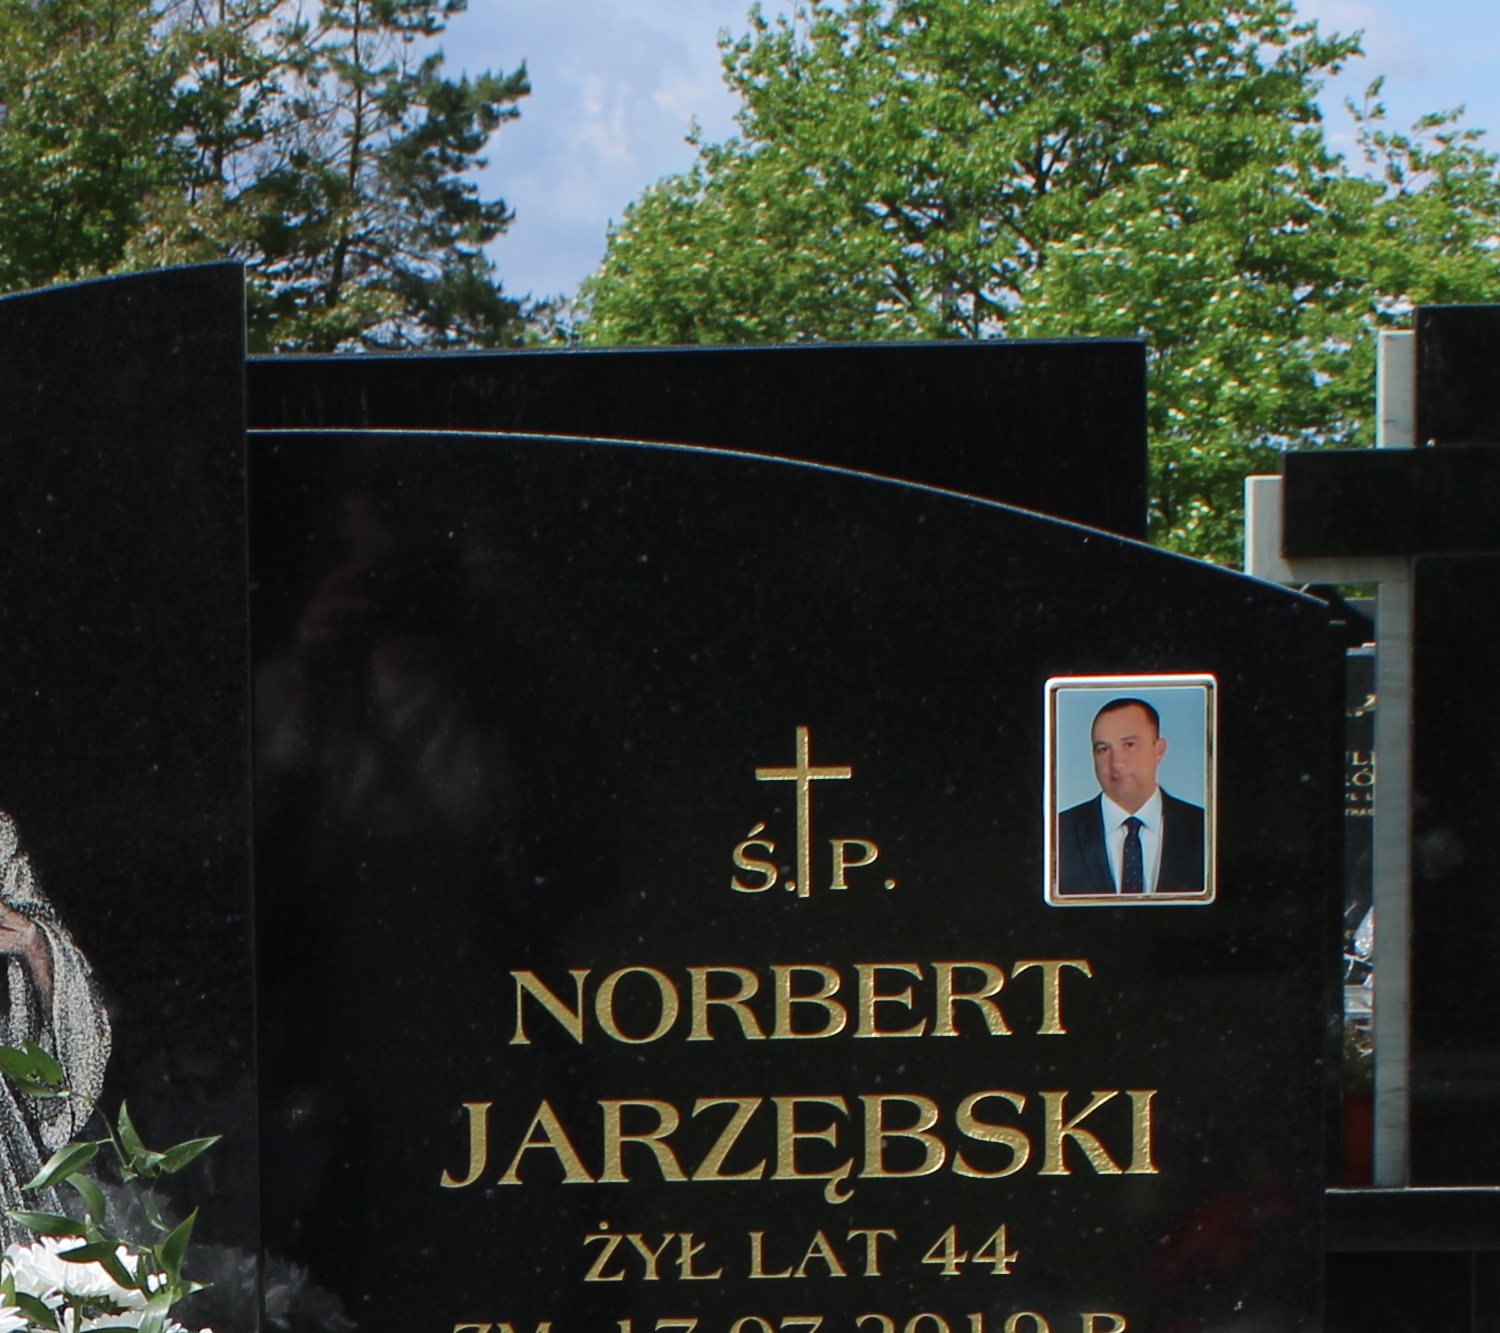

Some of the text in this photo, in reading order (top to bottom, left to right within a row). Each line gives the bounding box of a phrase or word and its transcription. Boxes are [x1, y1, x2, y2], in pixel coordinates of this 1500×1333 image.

[730, 822, 896, 893] Ś. P.
[509, 959, 1093, 1045] NORBERT
[440, 1089, 1160, 1205] JARZĘBSKI
[583, 1221, 1019, 1282] ŻYŁ LAT 44
